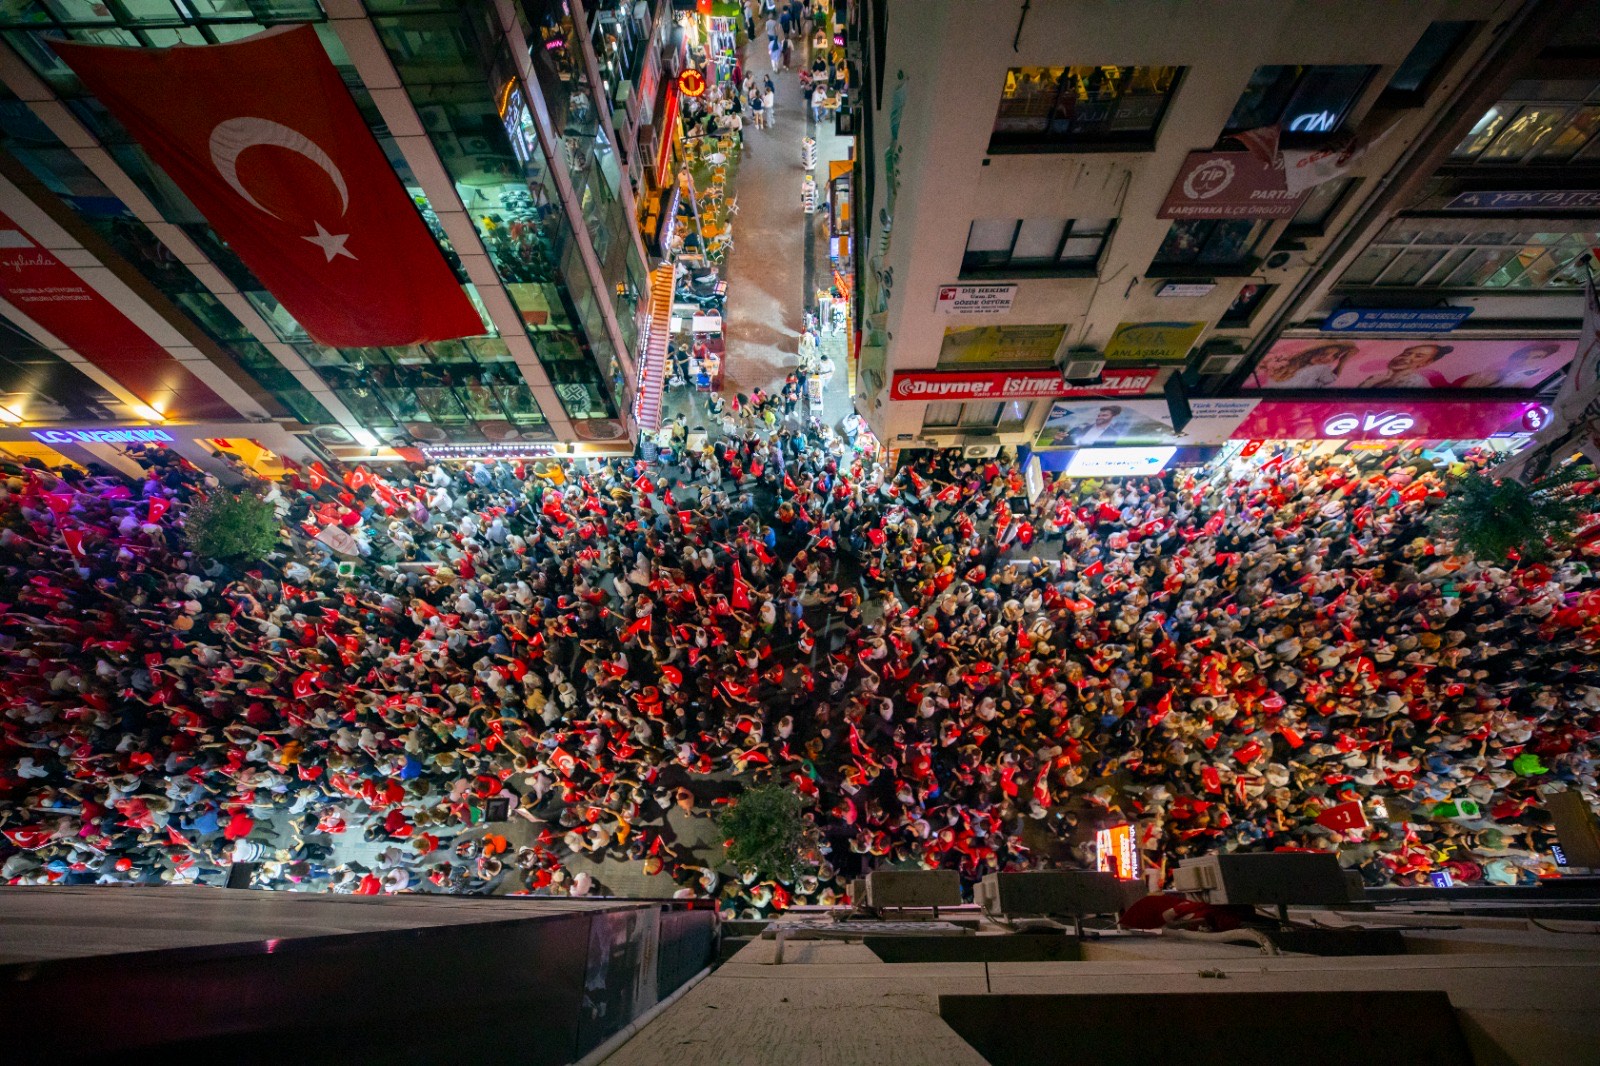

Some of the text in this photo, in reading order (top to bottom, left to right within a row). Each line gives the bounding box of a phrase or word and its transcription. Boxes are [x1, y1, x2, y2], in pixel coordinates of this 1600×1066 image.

[1201, 168, 1224, 181] TİP
[1167, 207, 1223, 215] KARŞIYAKA
[912, 380, 993, 394] Duymer
[1325, 414, 1414, 436] eve
[31, 430, 72, 443] LC
